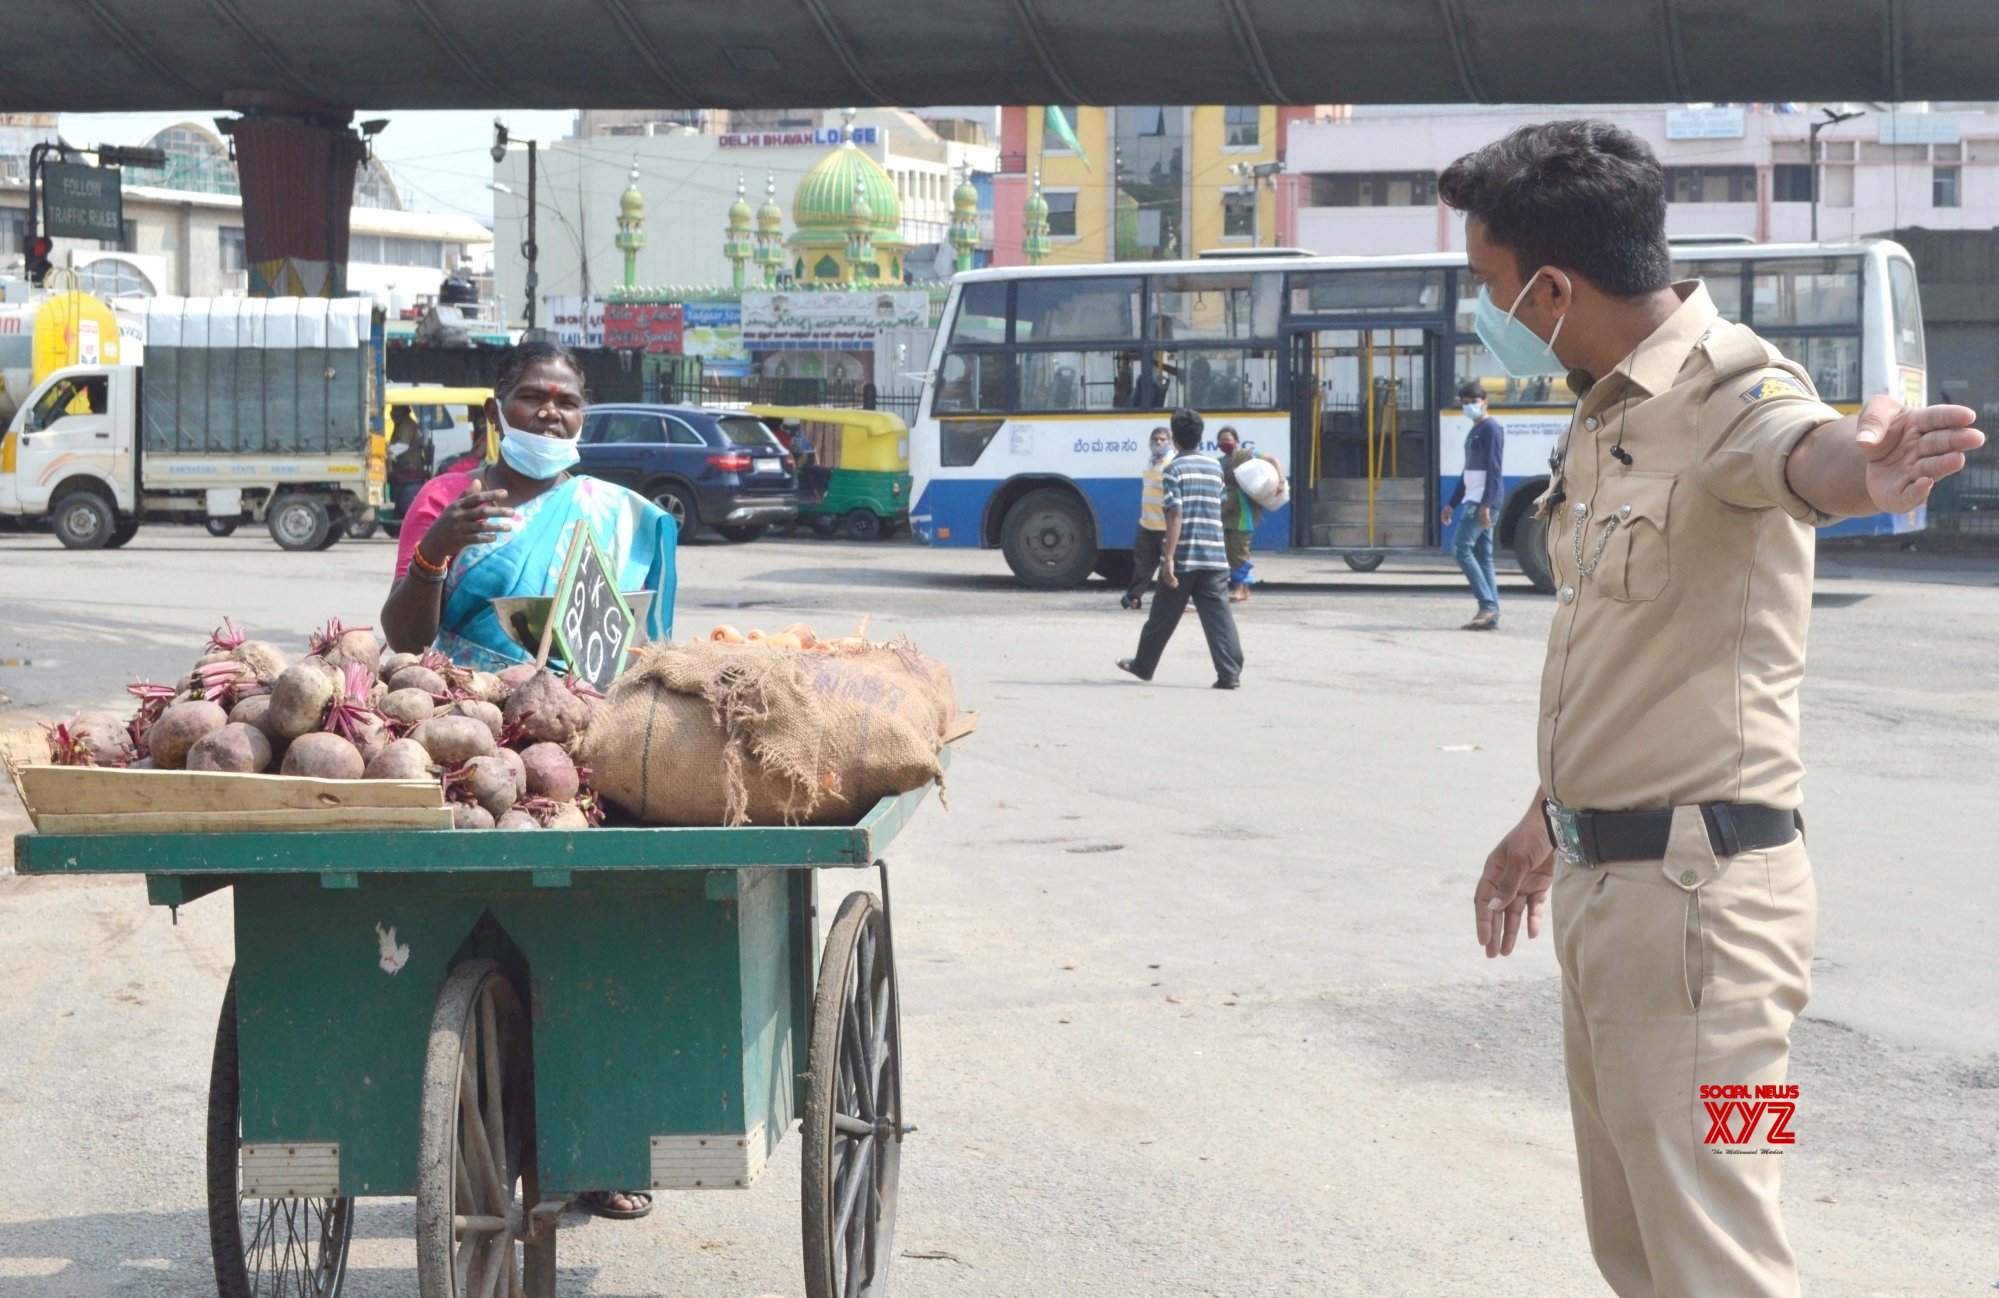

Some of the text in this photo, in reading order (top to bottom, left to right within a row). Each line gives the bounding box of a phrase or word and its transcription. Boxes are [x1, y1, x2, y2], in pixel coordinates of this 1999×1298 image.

[719, 135, 759, 147] DELHI
[764, 133, 813, 146] BHAVAN
[63, 177, 103, 197] FOLLOW
[48, 206, 118, 229] TRAFFIC RULES
[0, 315, 21, 334] m
